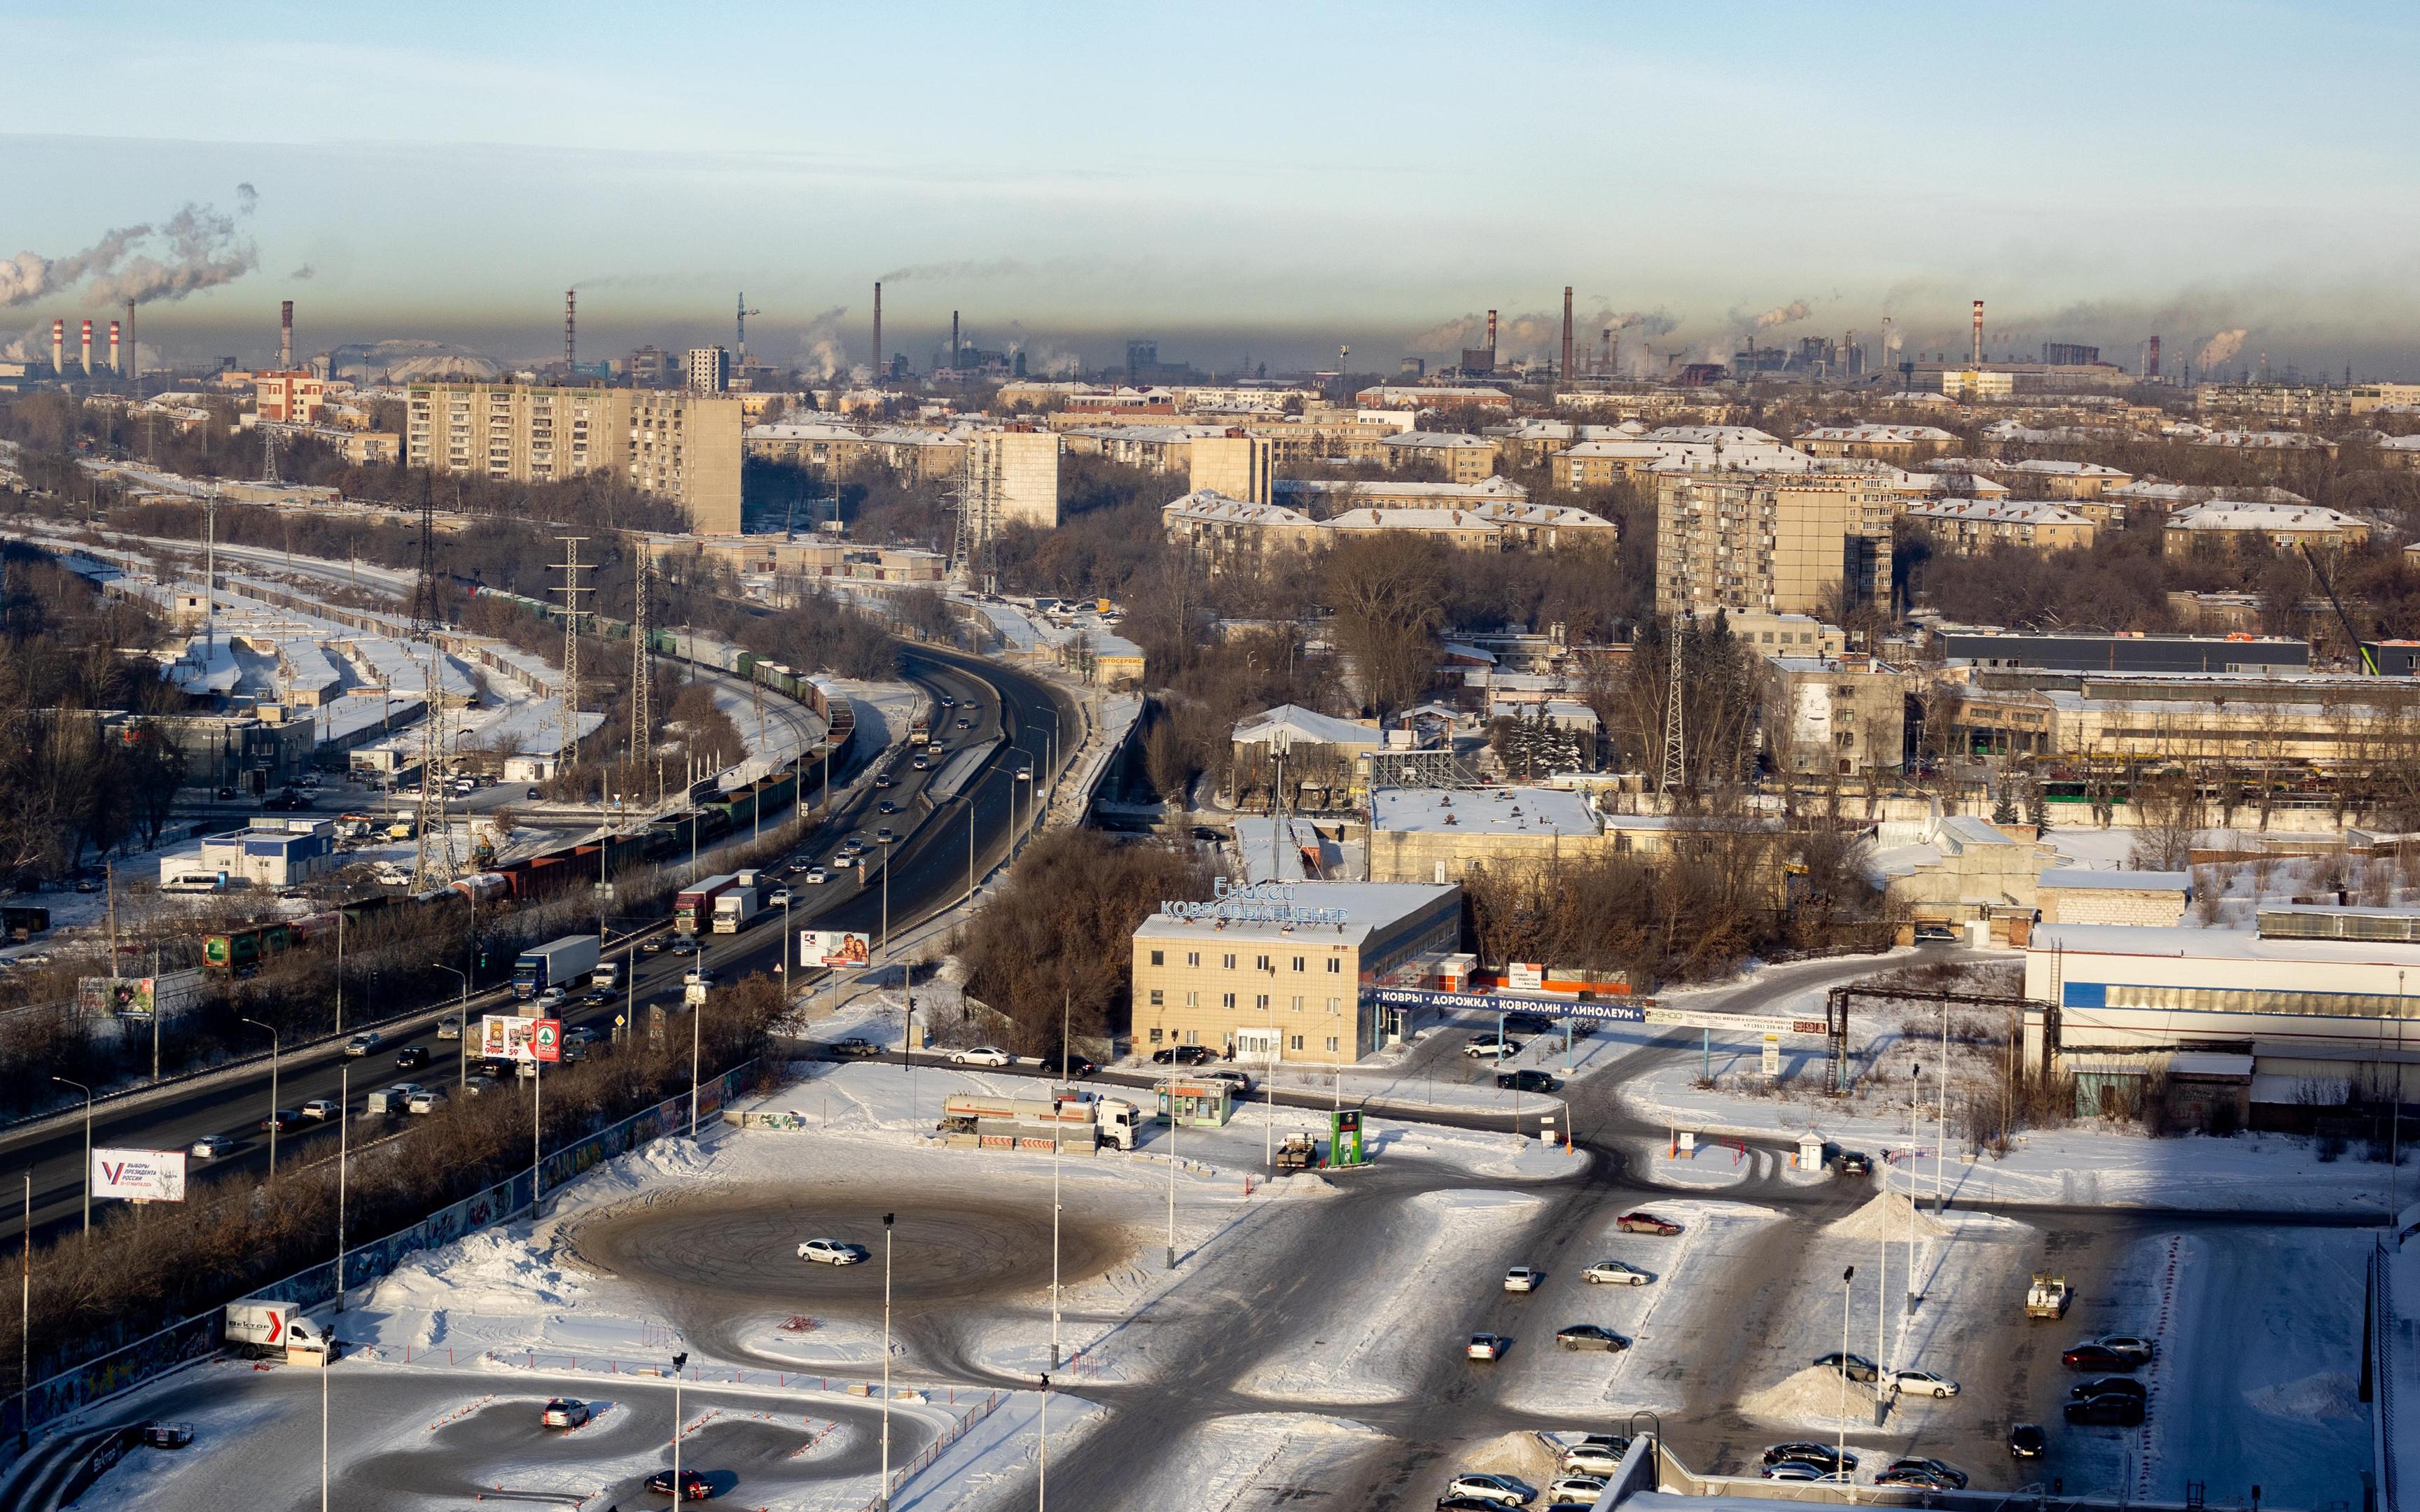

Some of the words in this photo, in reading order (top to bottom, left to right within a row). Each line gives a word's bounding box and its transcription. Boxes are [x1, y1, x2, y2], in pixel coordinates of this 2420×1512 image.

[1214, 876, 1295, 902] Енисей
[1283, 906, 1349, 923] ЦЕНТР
[1382, 991, 1422, 1003] КОВРЫ
[1432, 995, 1489, 1008] ДОРОЖКА
[1499, 999, 1561, 1014] КОВРОЛИН
[1571, 1004, 1634, 1019] ЛИНОЛЕУМ
